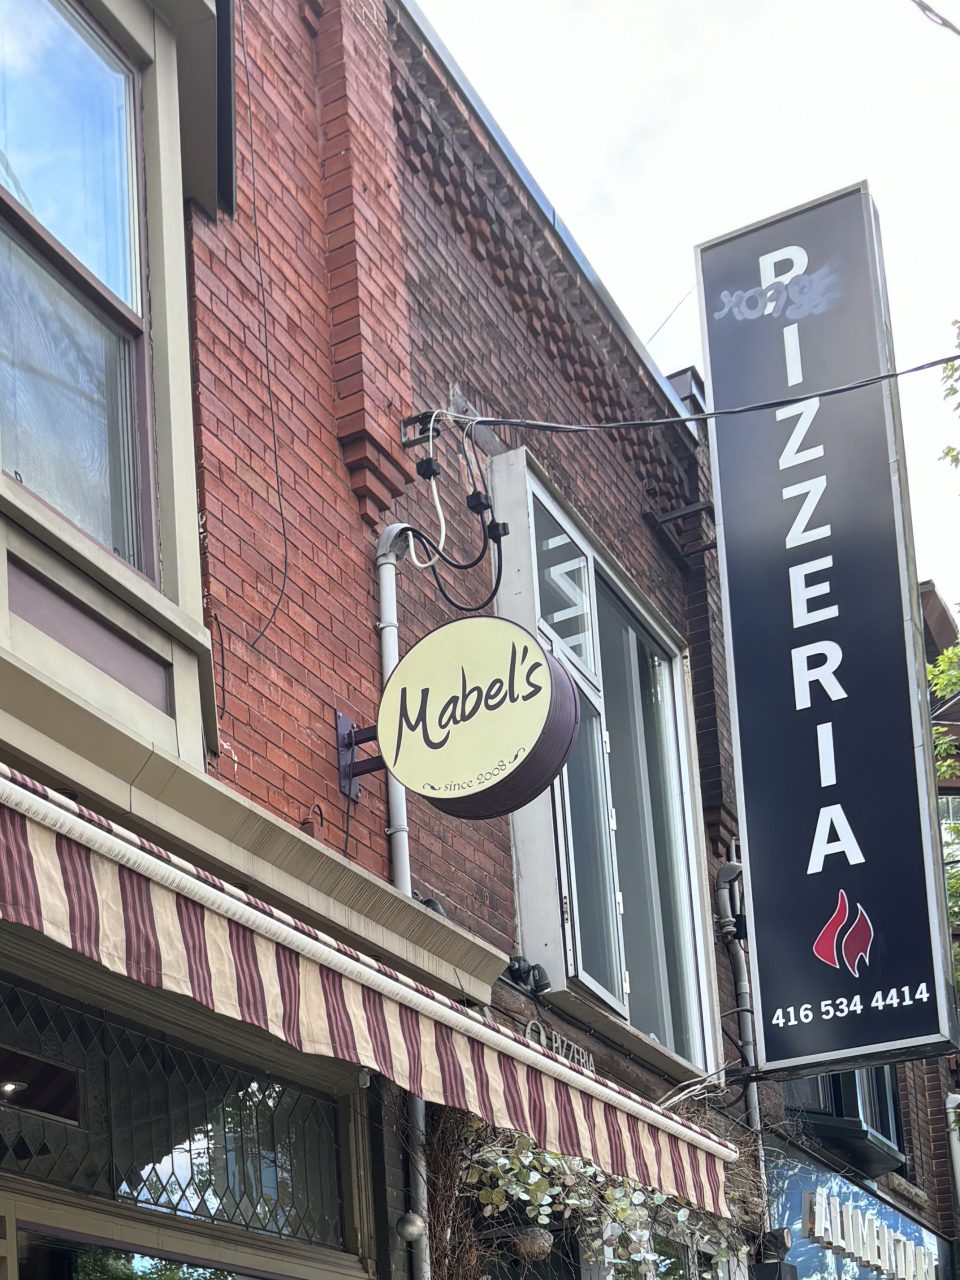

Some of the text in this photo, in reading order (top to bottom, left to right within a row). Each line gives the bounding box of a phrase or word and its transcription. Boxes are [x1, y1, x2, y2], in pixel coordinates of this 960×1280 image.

[758, 246, 866, 876] PIZZERIA
[392, 641, 543, 768] Mabel's
[443, 760, 507, 792] since 2008
[772, 982, 930, 1028] 416 534 4414
